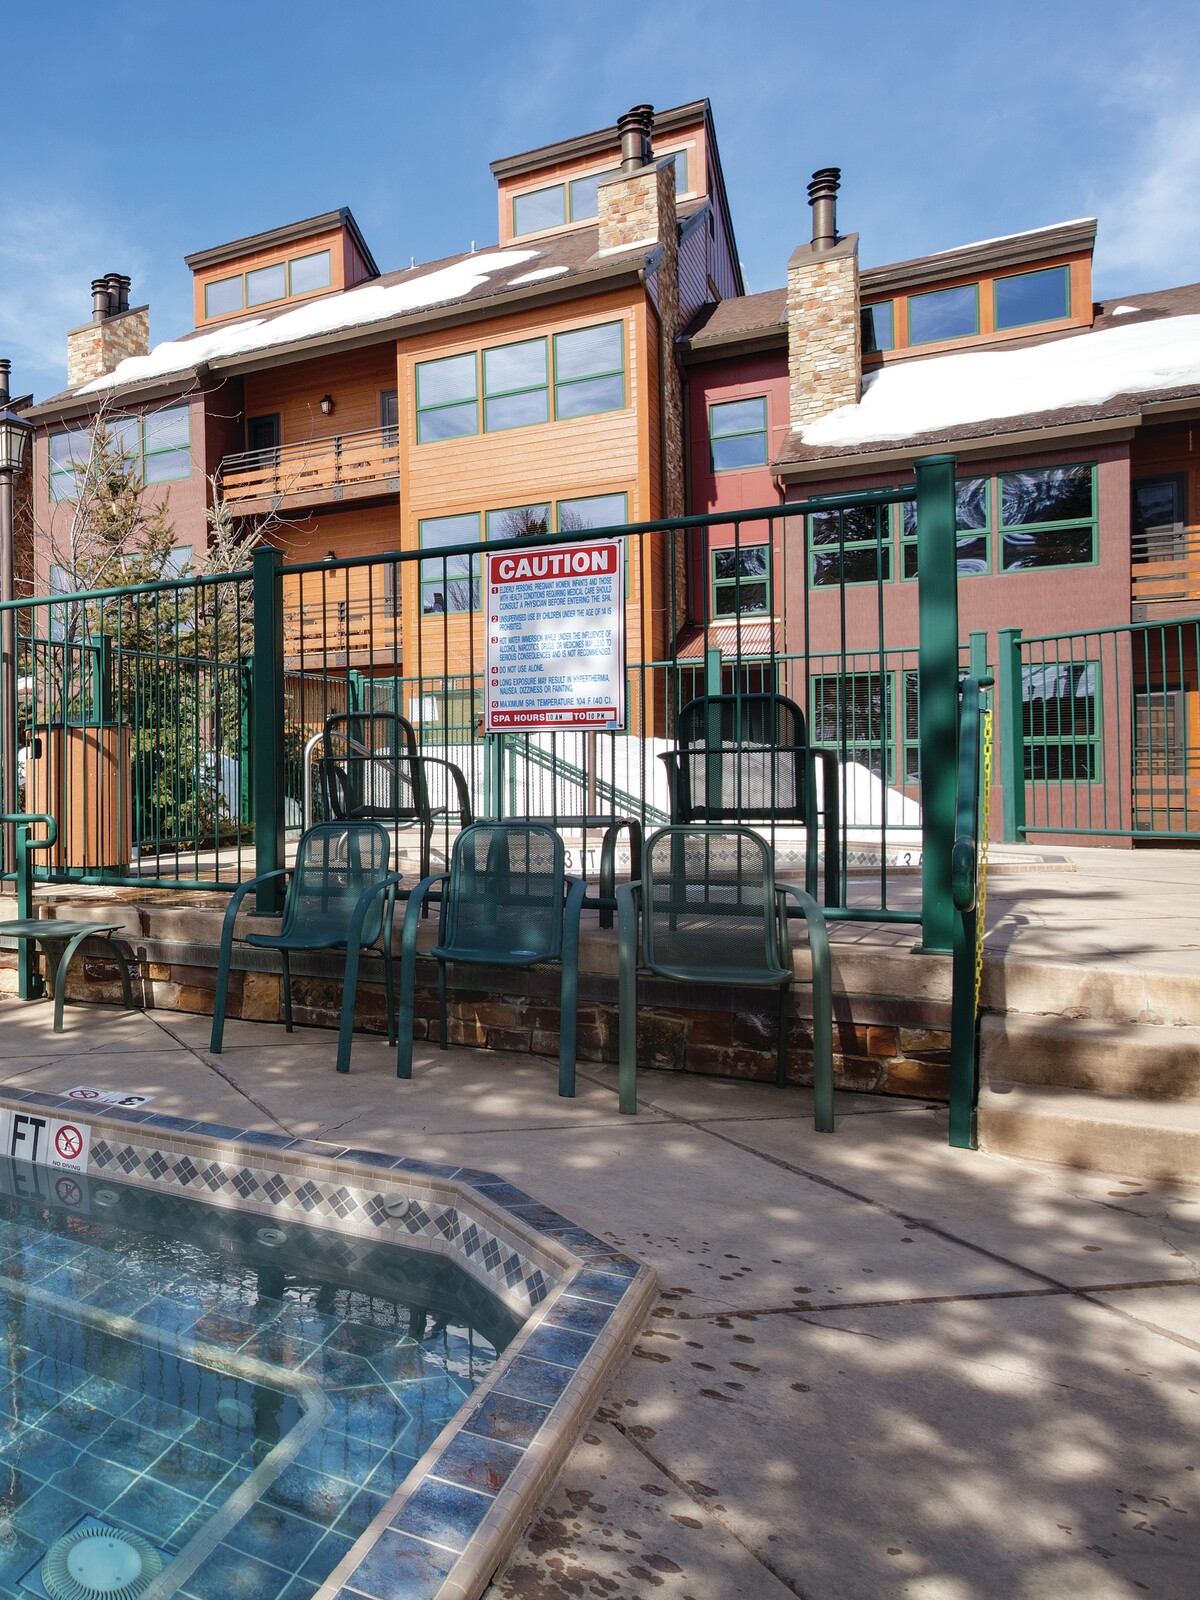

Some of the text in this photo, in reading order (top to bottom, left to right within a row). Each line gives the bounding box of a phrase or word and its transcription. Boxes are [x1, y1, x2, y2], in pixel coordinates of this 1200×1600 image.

[499, 551, 608, 579] CAUTION
[535, 582, 554, 590] PREGNANT
[572, 579, 588, 587] INFANTS
[510, 593, 522, 601] HEALTH
[523, 591, 545, 600] CONDITIONS
[546, 589, 566, 598] REQUIRING
[567, 588, 583, 596] MEDICAL
[585, 587, 595, 595] CARE
[596, 586, 612, 594] SHOULD
[500, 602, 518, 610] CONSULT
[525, 600, 546, 608] PHYSICIAN
[548, 598, 565, 606] BEFORE
[568, 596, 589, 604] ENTERING
[592, 595, 600, 603] THE
[500, 614, 526, 623] UNSUPERVISED
[543, 611, 561, 619] CHILDREN
[562, 610, 575, 618] UNDER
[585, 608, 593, 616] AGE
[522, 634, 543, 642] IMMERSION
[582, 630, 604, 639] INFLUENCE
[564, 640, 584, 648] MEDICINES
[500, 653, 516, 661] SERIOUS
[518, 651, 550, 660] CONSEQUENCES
[568, 649, 576, 657] NOT
[513, 677, 536, 685] EXPOSURE
[549, 676, 565, 684] RESULT
[520, 685, 543, 694] DIZZINESS
[500, 700, 523, 708] MAXIMUM
[537, 698, 574, 706] TEMPERATURE
[593, 697, 602, 705] (40
[514, 713, 545, 721] HOURS
[574, 712, 585, 720] TO
[564, 850, 572, 868] 3
[118, 1097, 145, 1105] 3
[11, 1114, 46, 1161] FT
